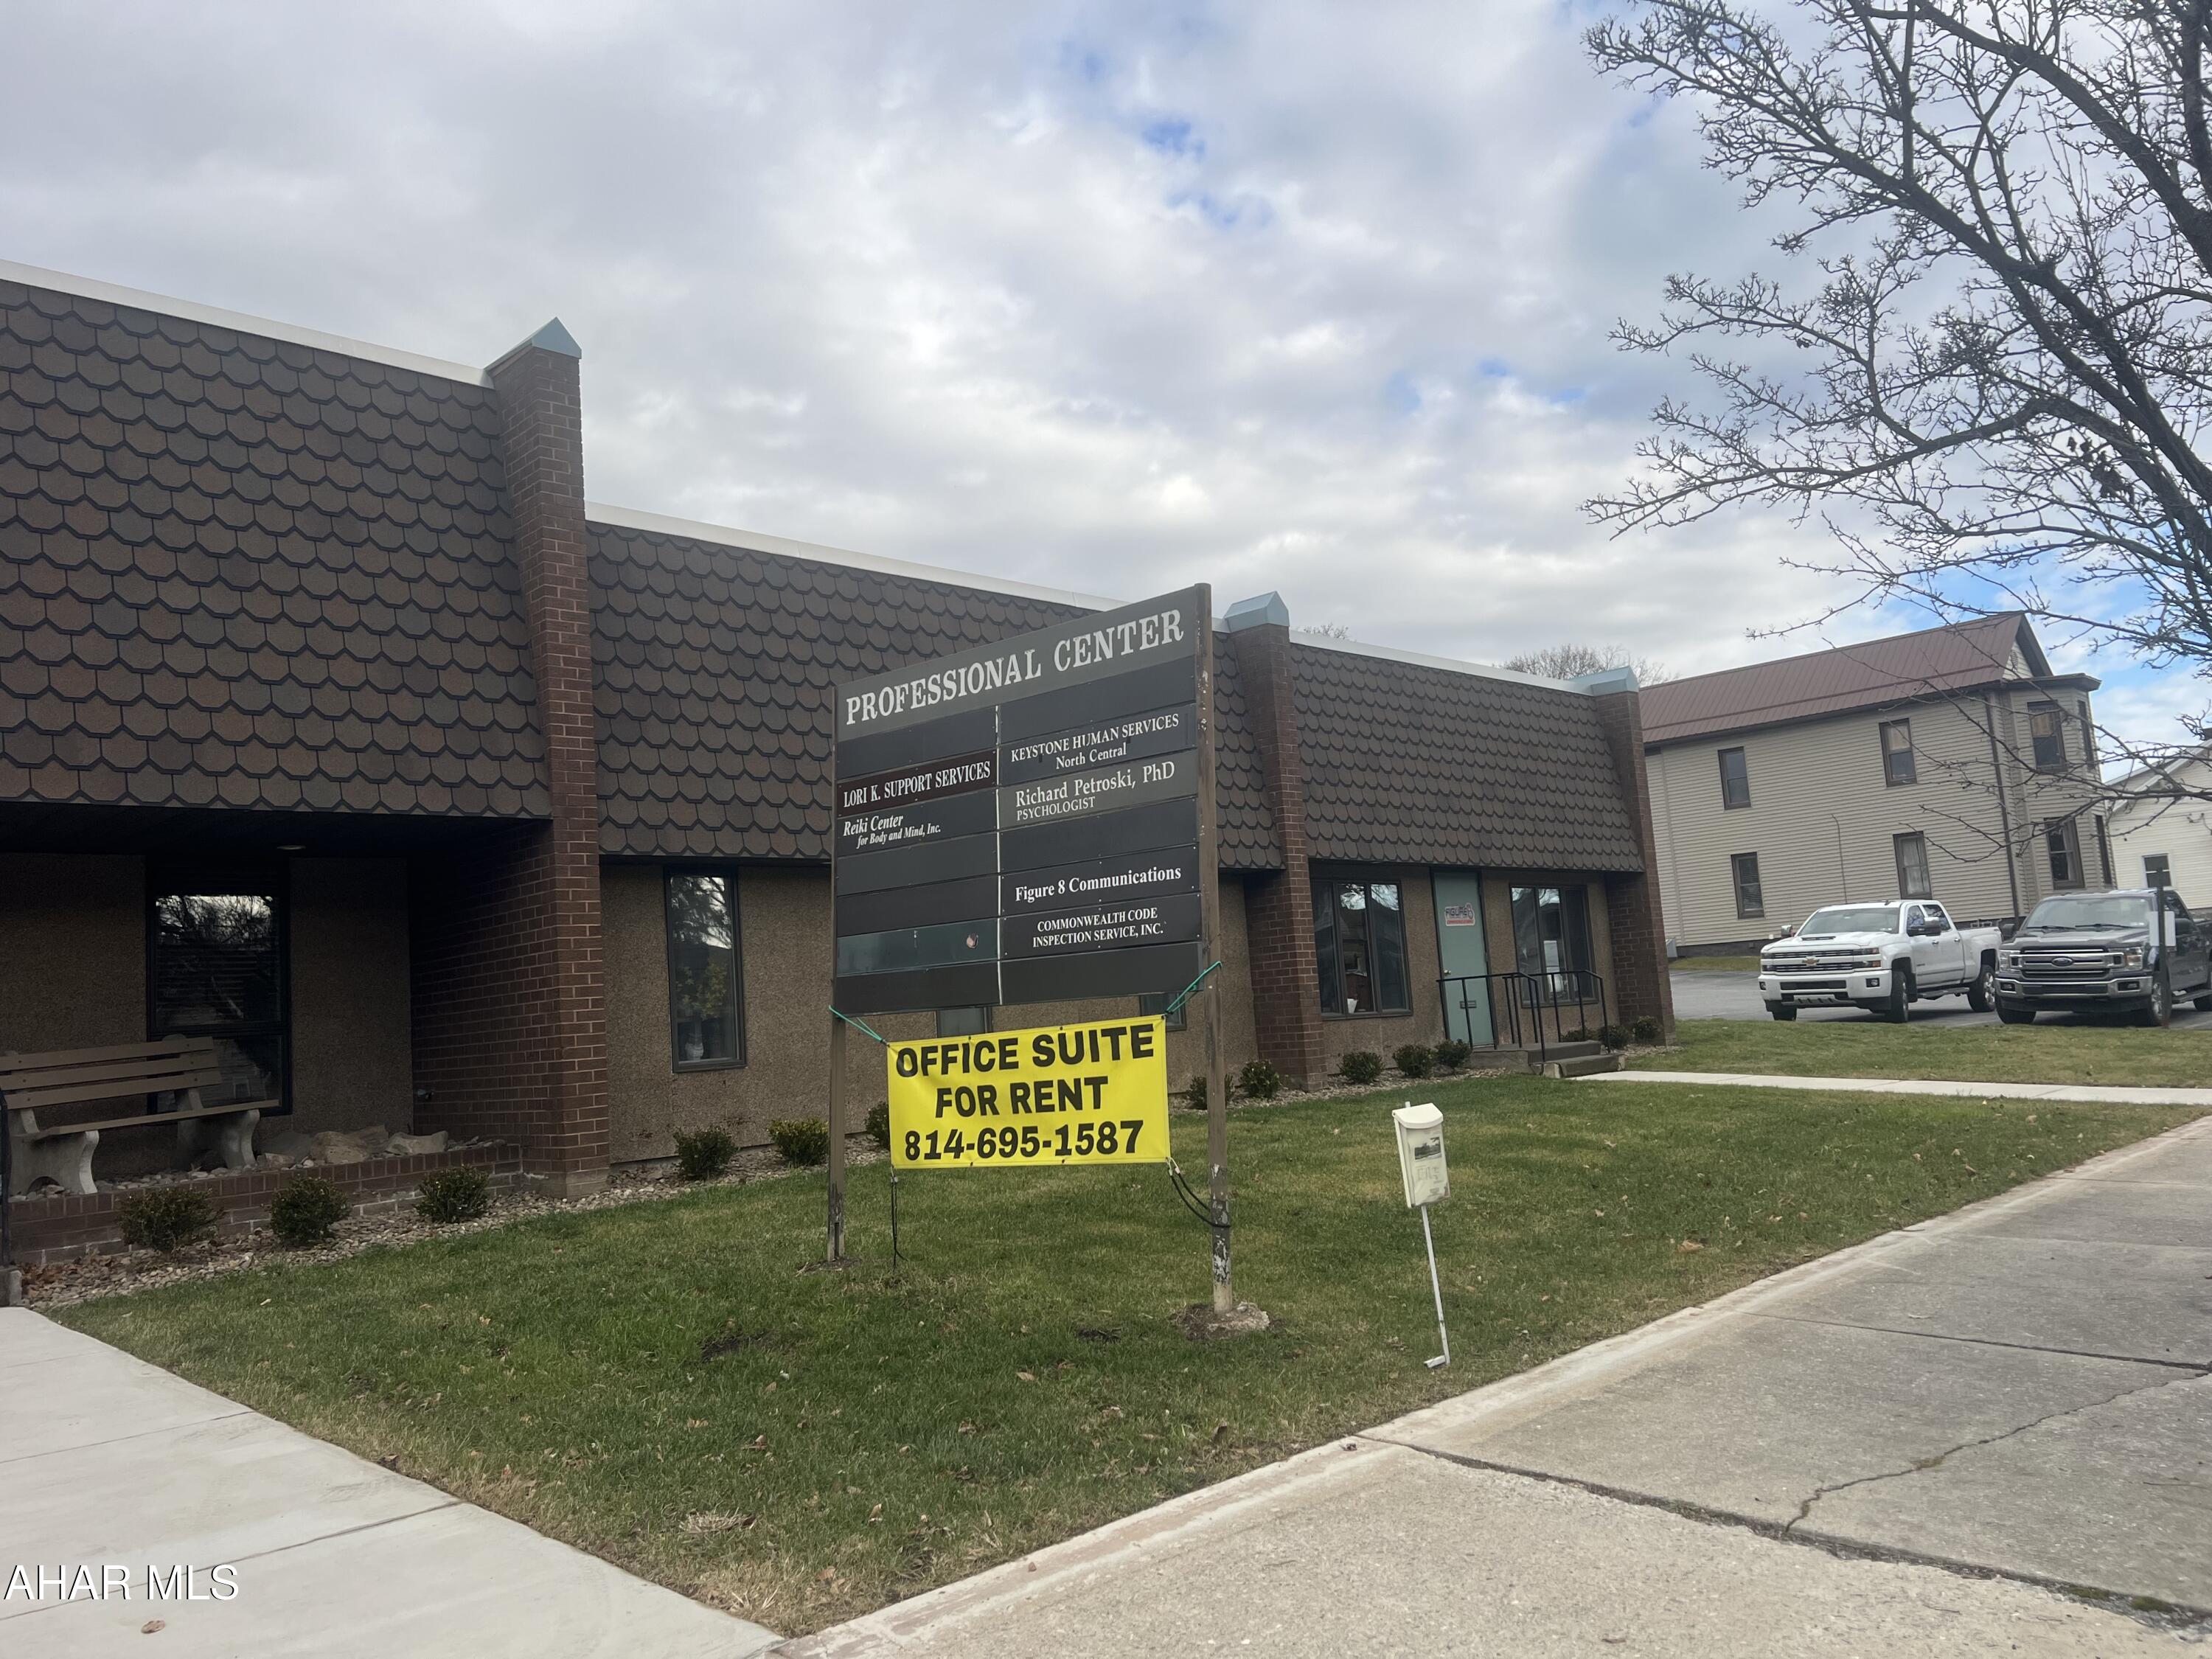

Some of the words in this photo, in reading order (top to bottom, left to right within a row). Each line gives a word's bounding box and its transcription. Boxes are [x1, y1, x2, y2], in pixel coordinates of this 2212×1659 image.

[846, 649, 1041, 725] PROFESSIONAL
[1054, 608, 1184, 671] CENTER
[1011, 738, 1069, 762] KEYSTONE
[1073, 727, 1119, 749] HUMAN
[1122, 713, 1179, 737] SERVICES
[1056, 754, 1086, 769] North
[1089, 742, 1127, 762] Central
[844, 787, 867, 807] LORI
[871, 785, 880, 801] K.
[885, 773, 932, 799] SUPPORT
[935, 761, 991, 788] SERVICES
[1016, 782, 1068, 807] Richard
[1074, 769, 1136, 796] Petroski,
[1143, 761, 1175, 783] PhD
[844, 818, 868, 837] Reiki
[871, 814, 903, 831] Center
[1017, 796, 1096, 821] PSYCHOLOGIST
[856, 835, 869, 849] for
[869, 831, 887, 845] Body
[888, 828, 902, 841] and
[903, 824, 925, 838] Mind,
[927, 823, 941, 834] Inc.
[1015, 885, 1055, 903] Figure
[1058, 880, 1065, 894] 8
[1069, 866, 1181, 892] Communications
[1033, 931, 1091, 947] INSPECTION
[1093, 926, 1138, 942] SERVICE,
[1141, 922, 1164, 935] INC.
[1037, 911, 1125, 932] COMMONWEALTH
[1127, 907, 1158, 920] CODE
[896, 1037, 1019, 1078] OFFICE
[1032, 1023, 1154, 1067] SUITE
[936, 1085, 1000, 1118] FOR
[1010, 1076, 1108, 1114] RENT
[905, 1120, 1144, 1161] 814-695-1587
